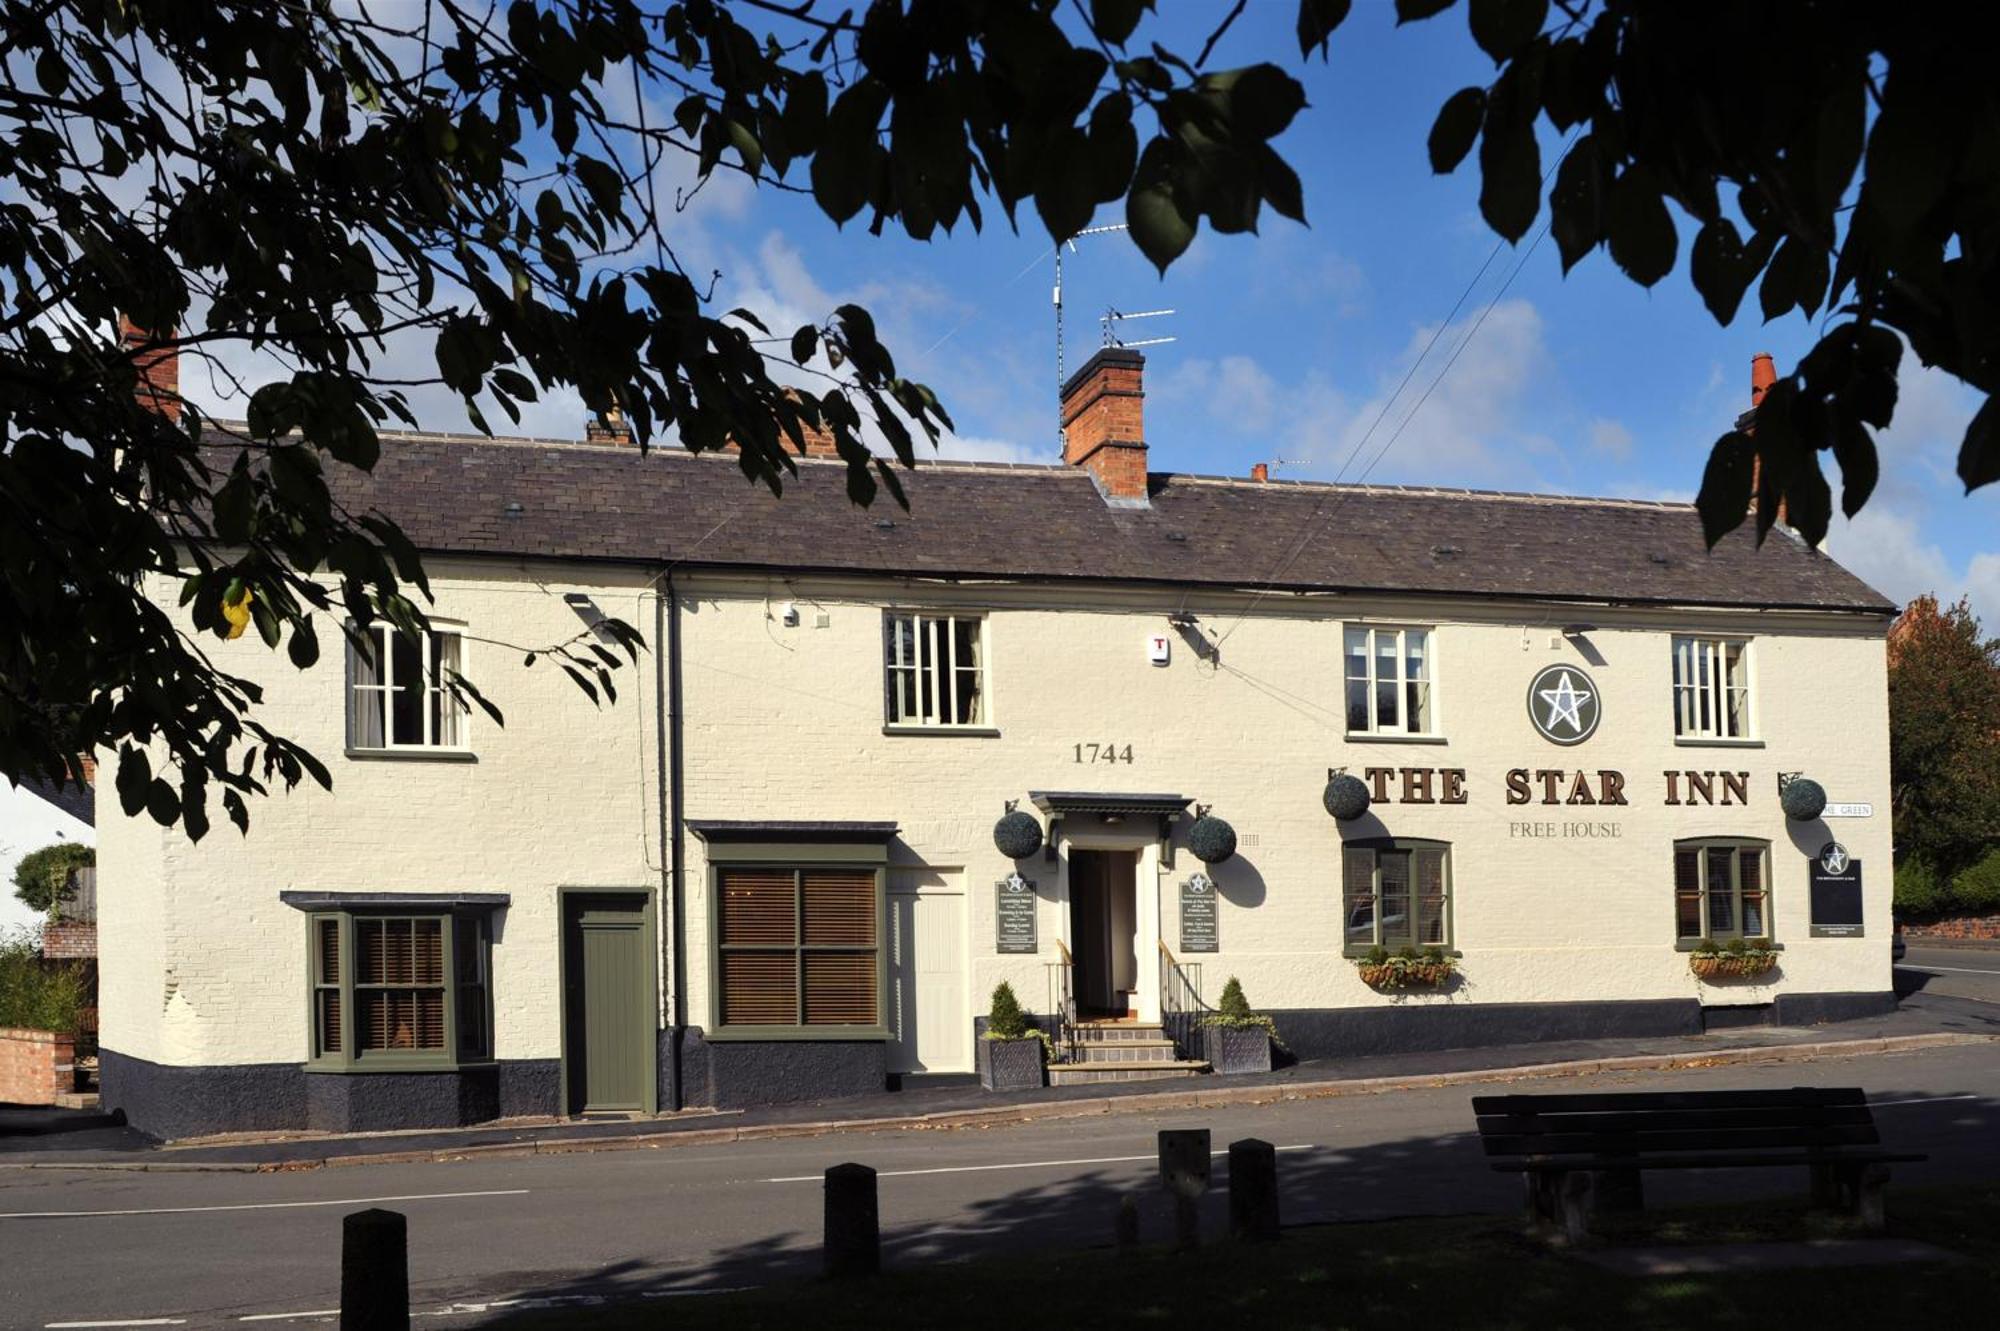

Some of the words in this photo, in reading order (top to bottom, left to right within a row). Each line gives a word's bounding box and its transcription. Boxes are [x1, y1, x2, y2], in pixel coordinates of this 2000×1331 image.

[1073, 743, 1135, 765] 1744
[1365, 767, 1468, 804] THE
[1506, 768, 1629, 805] STAR
[1663, 770, 1750, 806] INN
[1841, 806, 1869, 815] GREEN
[1510, 822, 1556, 838] FREE
[1563, 822, 1622, 838] HOUSE
